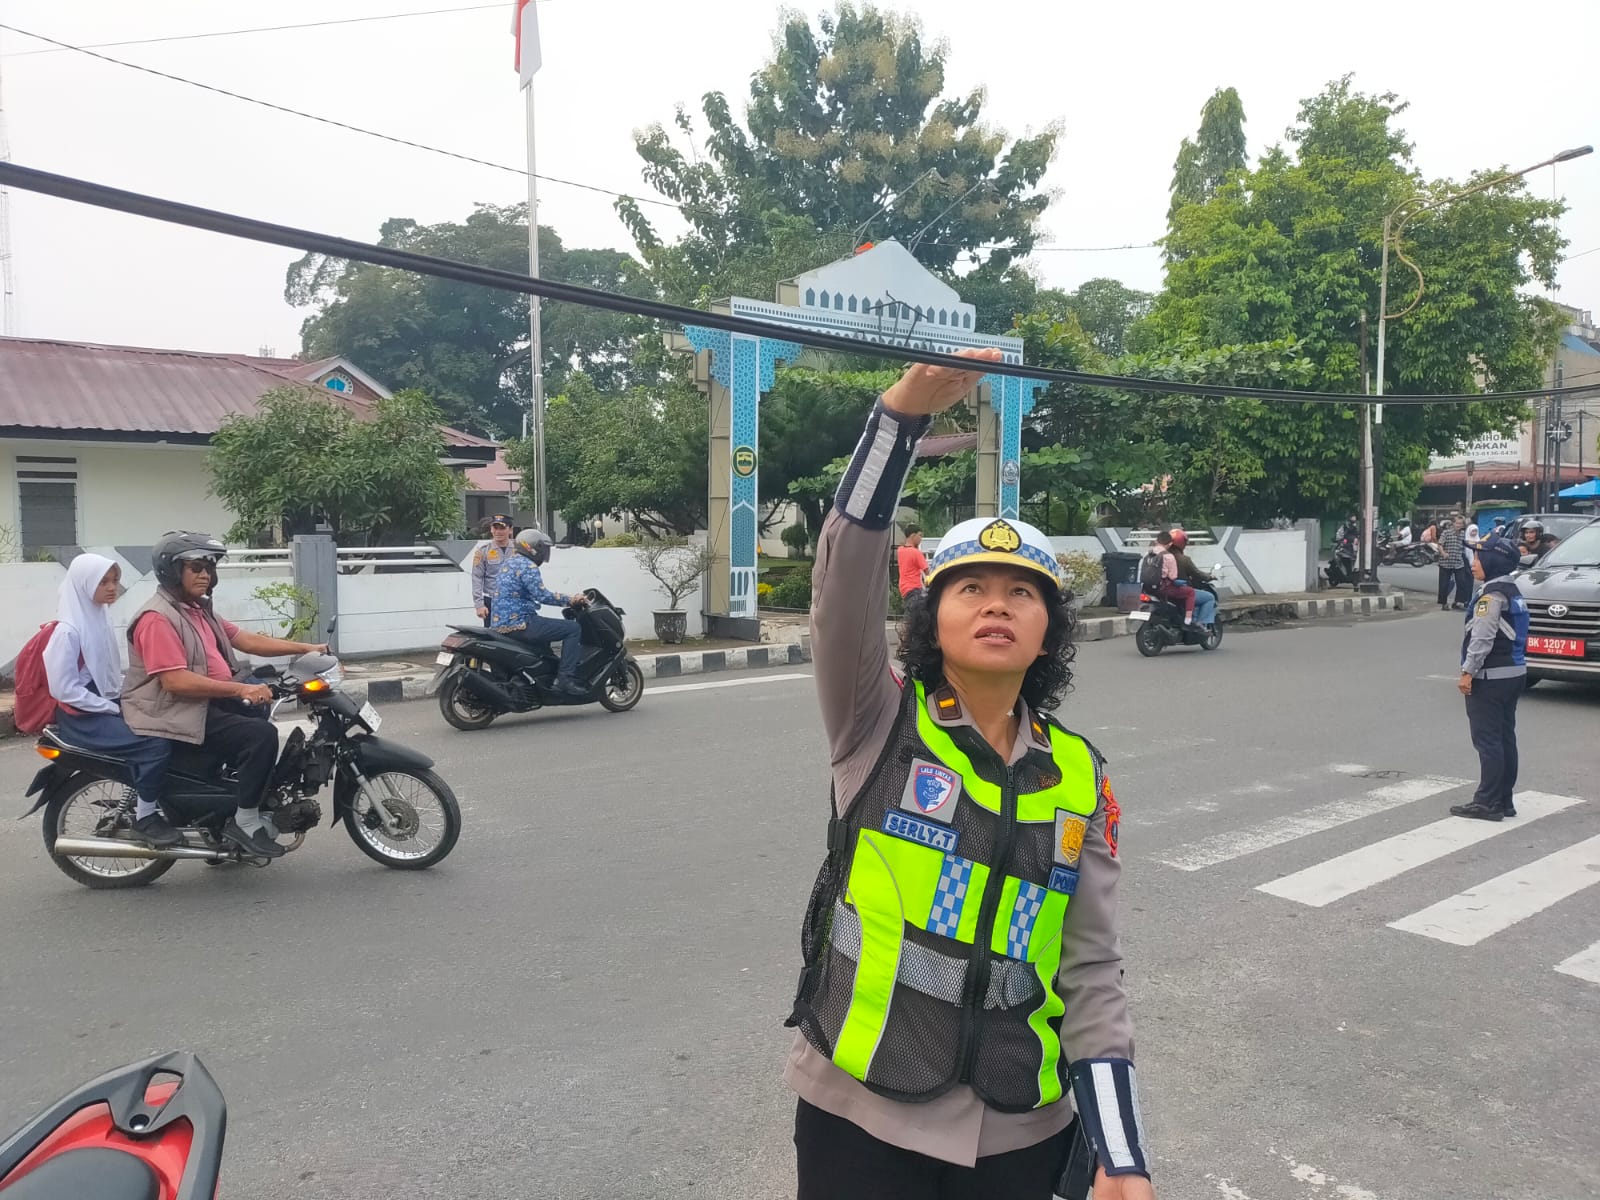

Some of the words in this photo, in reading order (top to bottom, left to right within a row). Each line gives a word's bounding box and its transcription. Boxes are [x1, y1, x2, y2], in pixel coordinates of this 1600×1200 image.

[1528, 637, 1540, 647] BK
[1543, 638, 1566, 649] 1207
[888, 816, 954, 849] SERLY.T
